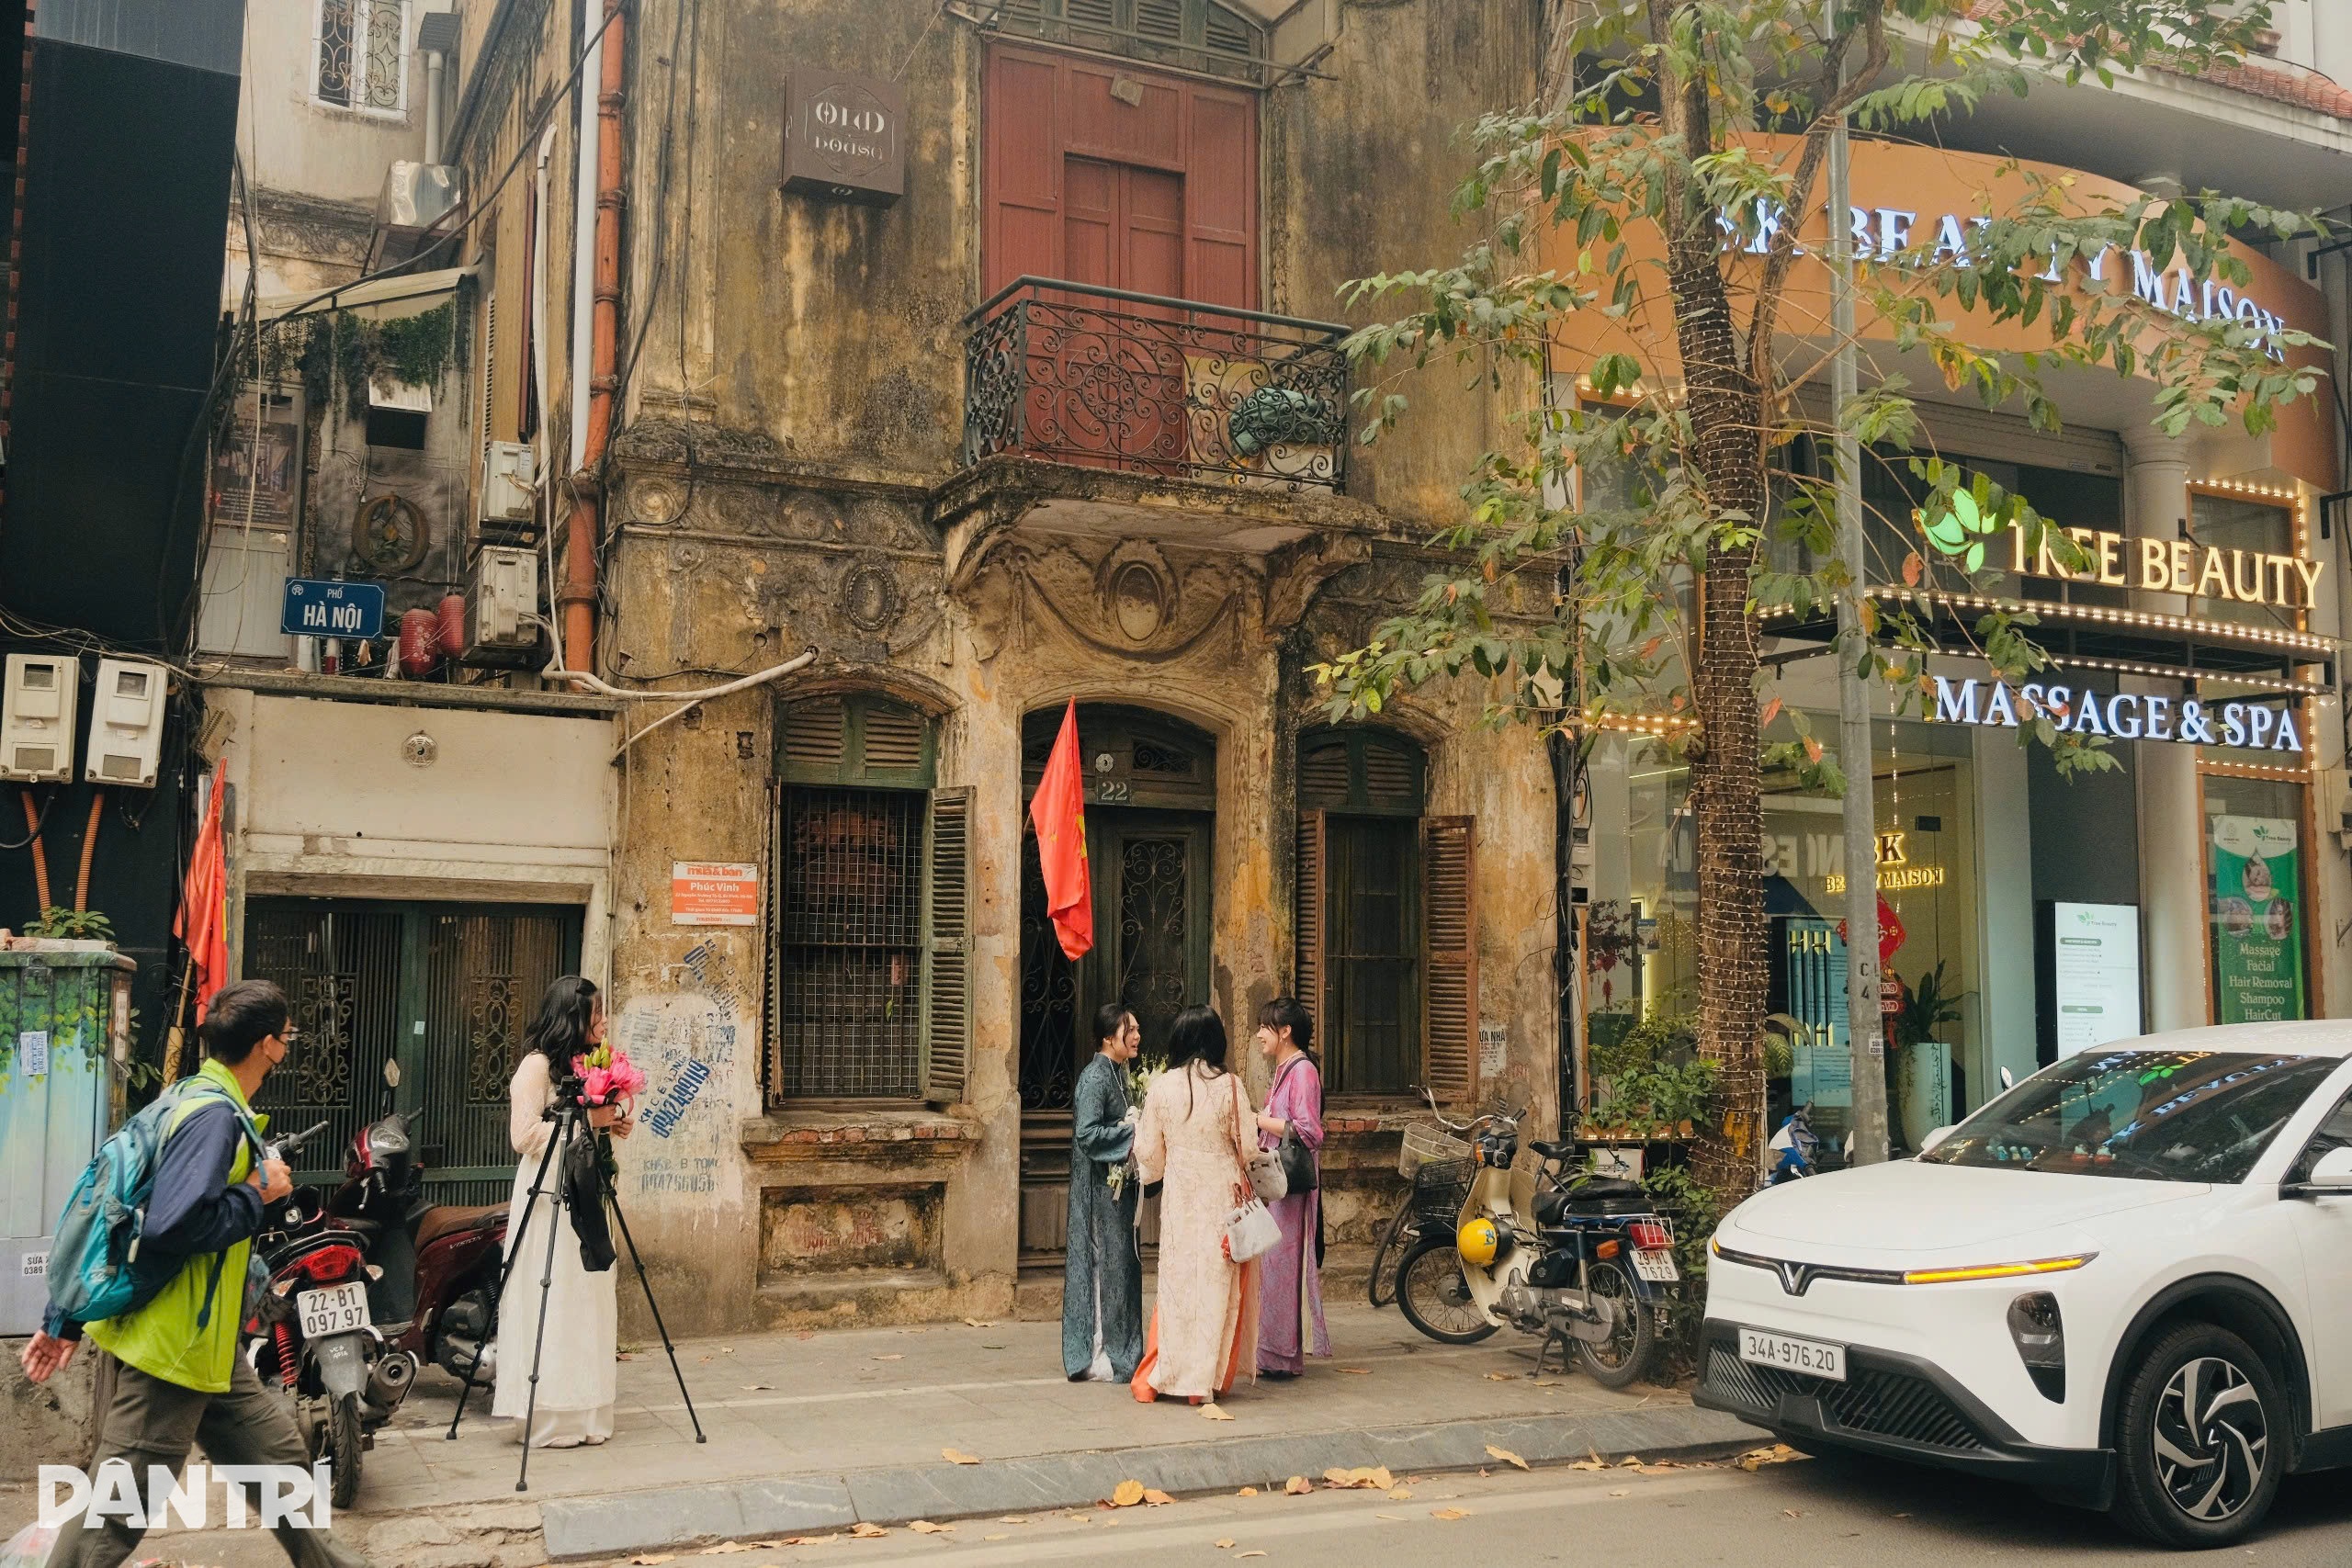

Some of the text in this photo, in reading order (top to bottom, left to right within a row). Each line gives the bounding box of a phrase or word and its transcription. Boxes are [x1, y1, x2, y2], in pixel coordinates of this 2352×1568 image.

[2130, 249, 2286, 364] MAISON
[2141, 536, 2324, 610] BEAUTY
[327, 586, 344, 599] PHỐ
[303, 601, 363, 633] HÀ NỘI
[1932, 675, 2173, 739] MASSAGE
[2223, 702, 2303, 752] SPA
[1102, 781, 1127, 801] 22
[690, 882, 715, 891] Phúc
[1884, 868, 1943, 887] MAISON
[2240, 943, 2281, 956] Massage
[2247, 960, 2275, 972] Facial
[2229, 976, 2292, 988] Hair Removal
[2240, 992, 2285, 1005] Shampoo
[1490, 1028, 1506, 1042] NHÀ
[1642, 1266, 1673, 1280] 7629
[309, 1286, 356, 1314] 22-B1
[306, 1306, 364, 1335] 097.97
[1748, 1336, 1835, 1371] 34A-976.20
